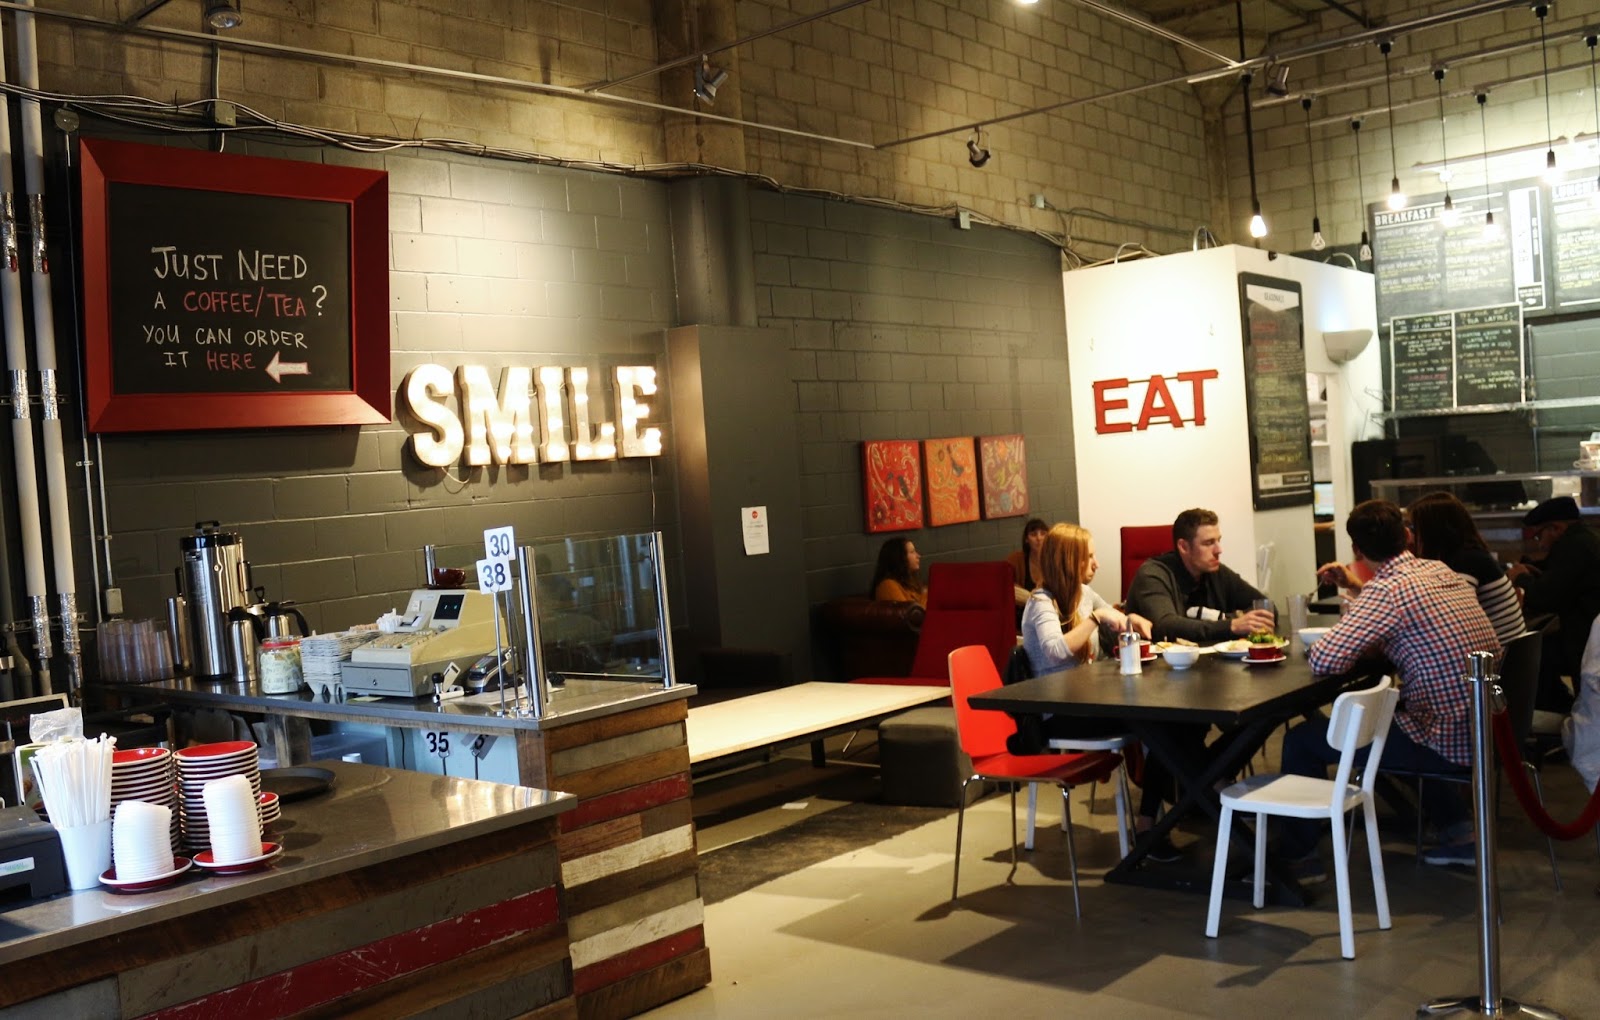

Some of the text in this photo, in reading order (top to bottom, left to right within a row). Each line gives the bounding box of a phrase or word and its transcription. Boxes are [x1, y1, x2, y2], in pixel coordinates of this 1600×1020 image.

[1374, 207, 1433, 226] BREAKFAST
[151, 245, 308, 281] JUST NEED
[154, 291, 166, 310] A
[142, 324, 308, 349] YOU CAN ORDER
[163, 350, 256, 371] IT HERE
[1093, 369, 1218, 435] EAT
[405, 363, 662, 467] SMILE
[490, 533, 510, 557] 30
[482, 562, 506, 588] 38
[426, 731, 449, 753] 35
